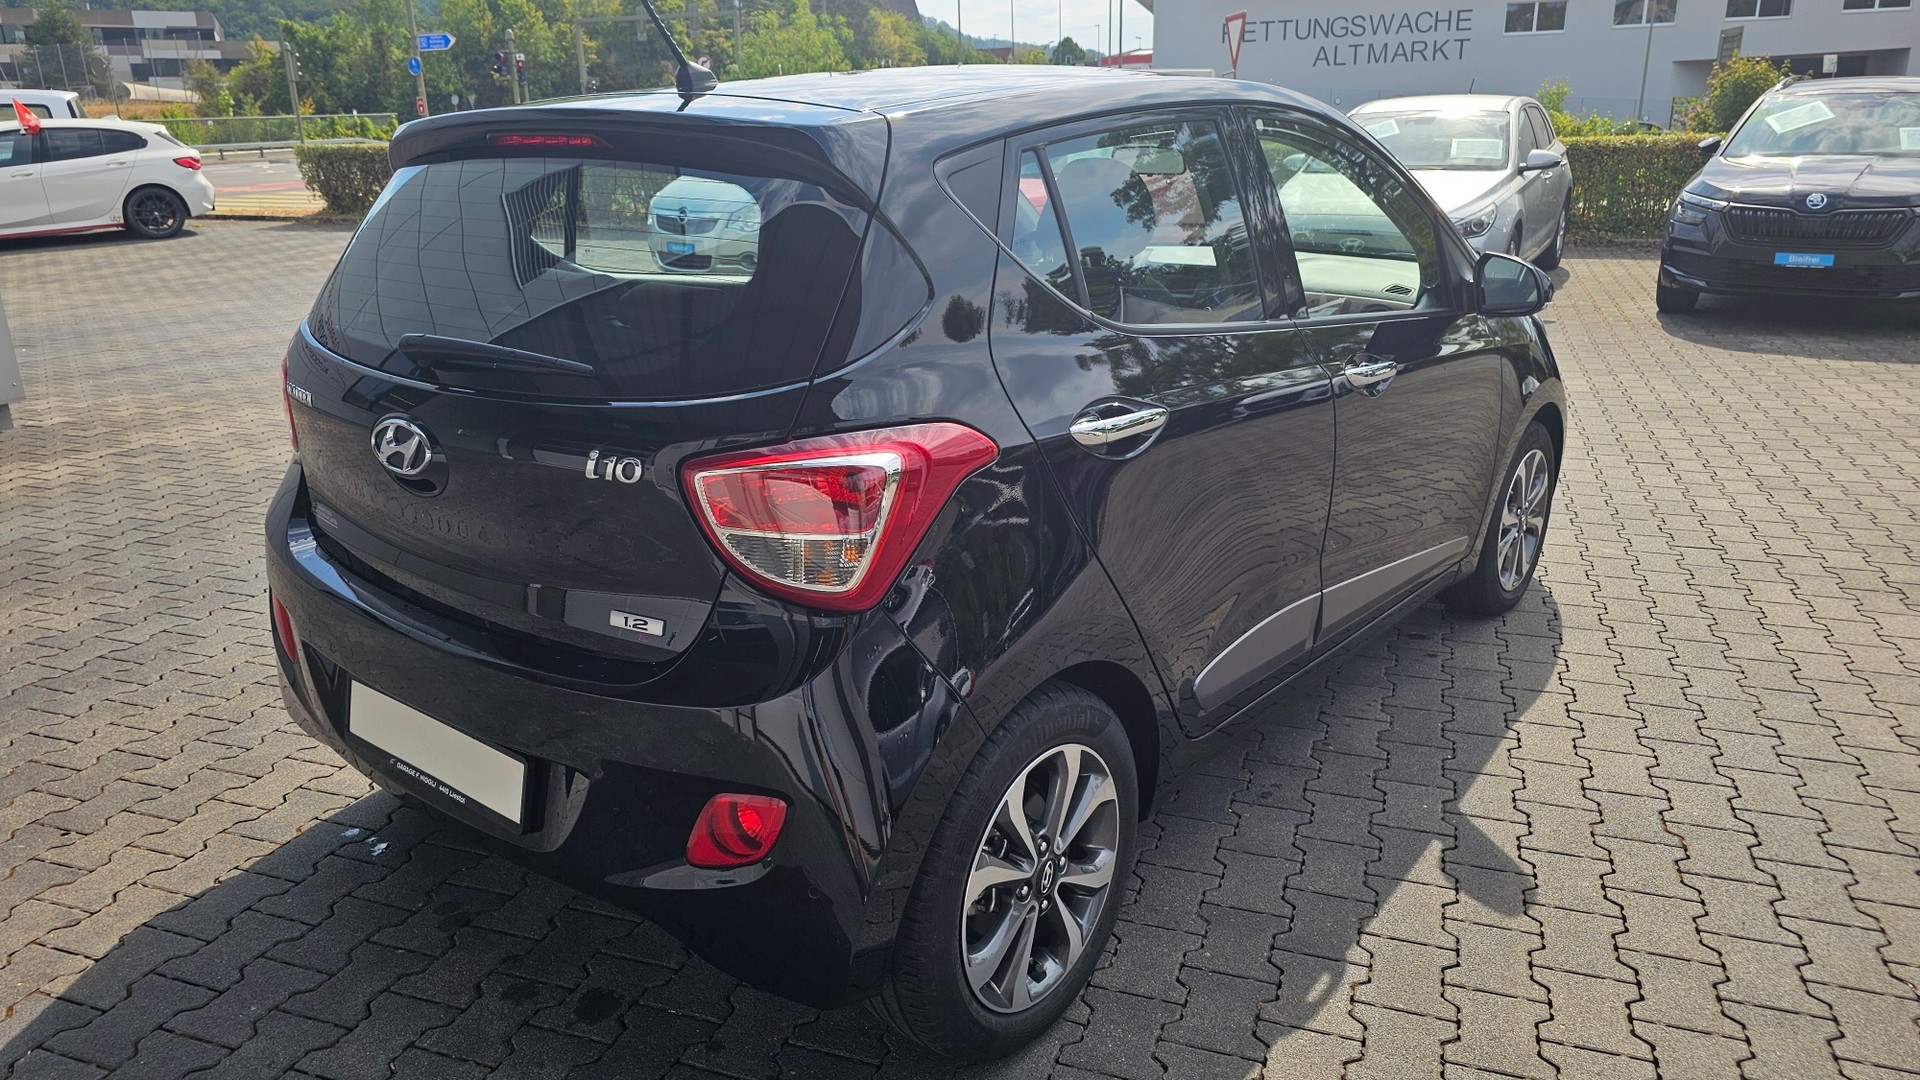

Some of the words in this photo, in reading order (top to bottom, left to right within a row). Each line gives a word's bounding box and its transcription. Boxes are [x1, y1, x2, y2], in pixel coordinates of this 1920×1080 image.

[1312, 38, 1471, 67] ALTMARKT
[1789, 254, 1820, 264] Bleifrei
[585, 449, 642, 484] i10
[623, 616, 649, 631] 1.2
[396, 762, 416, 777] GARAGE
